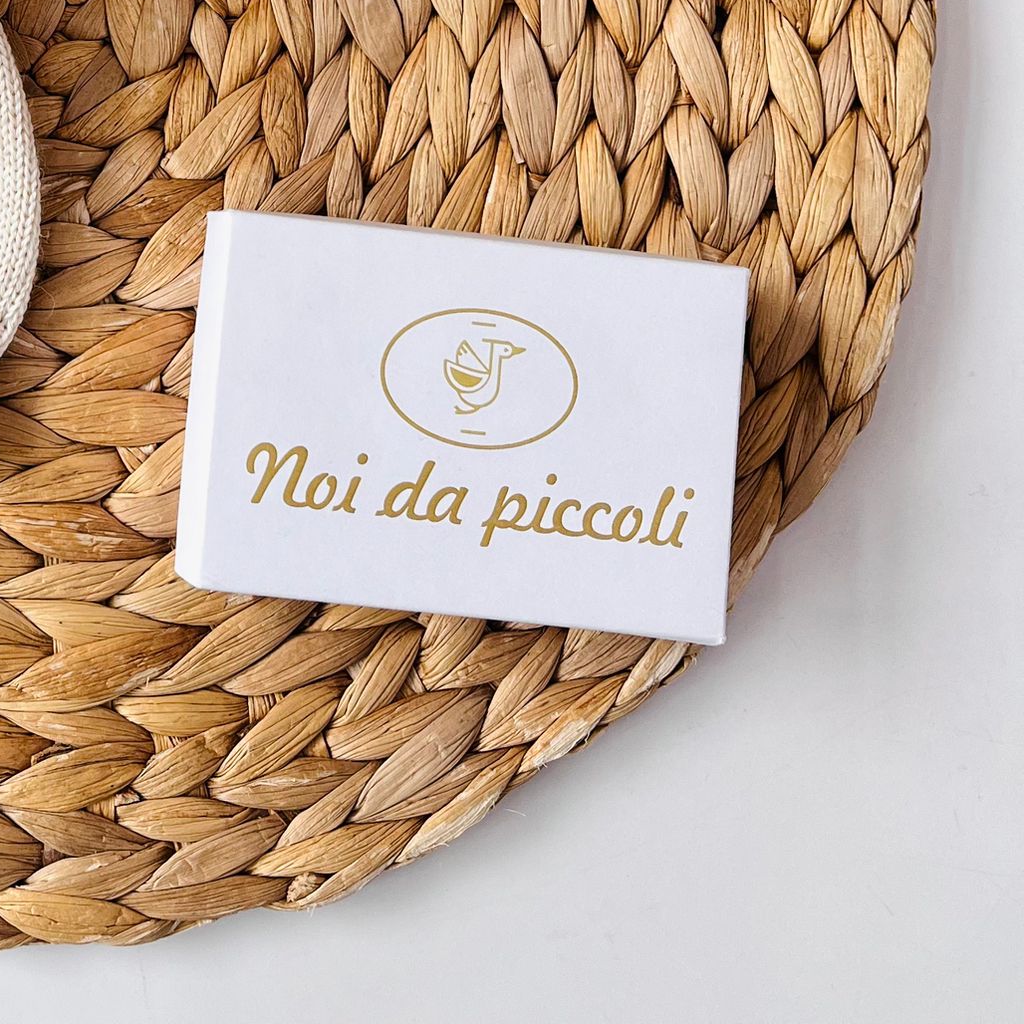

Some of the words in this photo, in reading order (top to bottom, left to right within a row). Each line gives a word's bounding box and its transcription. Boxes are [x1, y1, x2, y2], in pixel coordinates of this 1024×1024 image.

[246, 442, 369, 514] Noi
[376, 460, 469, 525] da
[480, 474, 695, 548] piccoli
